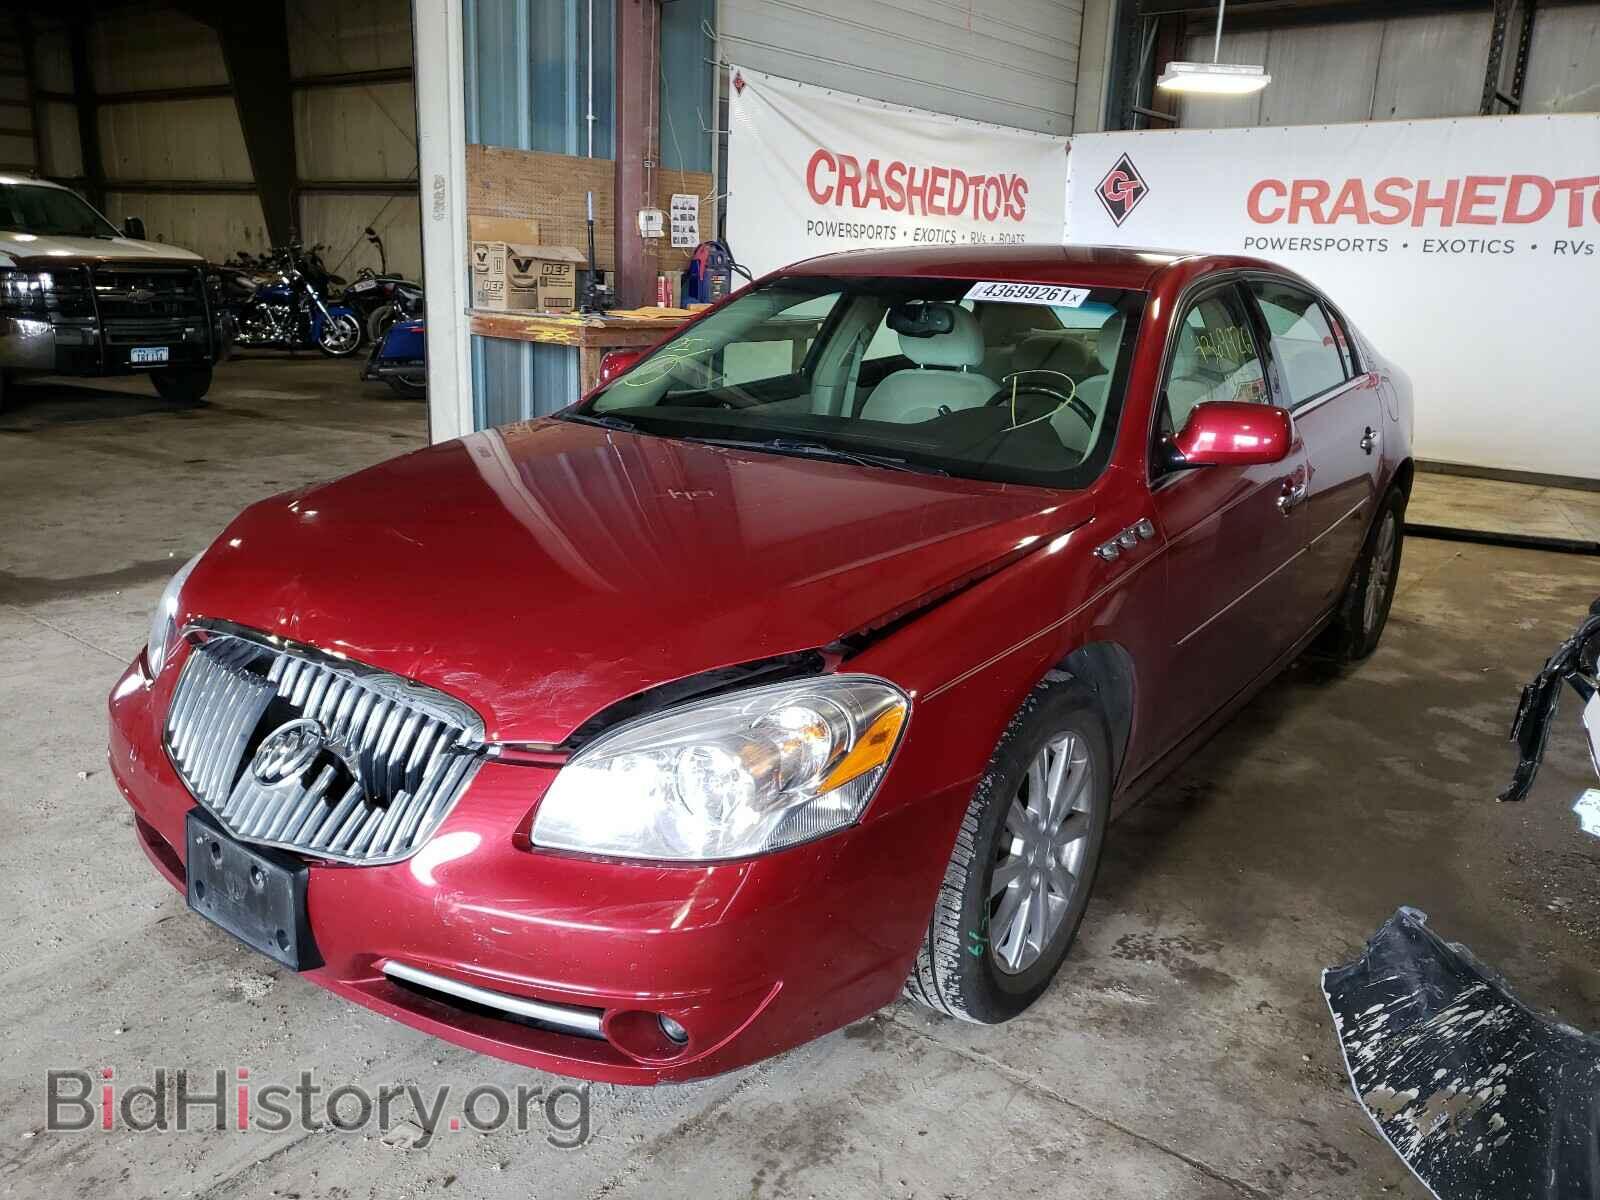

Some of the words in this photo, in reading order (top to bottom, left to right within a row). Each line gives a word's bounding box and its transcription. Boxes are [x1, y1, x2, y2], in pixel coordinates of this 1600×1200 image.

[806, 148, 1029, 222] CRASHEDTOYS
[807, 220, 897, 241] POWERSPORTS
[913, 227, 957, 244] EXOTICS
[1244, 236, 1389, 252] POWERSPORTS
[1422, 239, 1516, 254] EXOTICS
[1553, 240, 1595, 255] RVs
[542, 263, 570, 275] DEF
